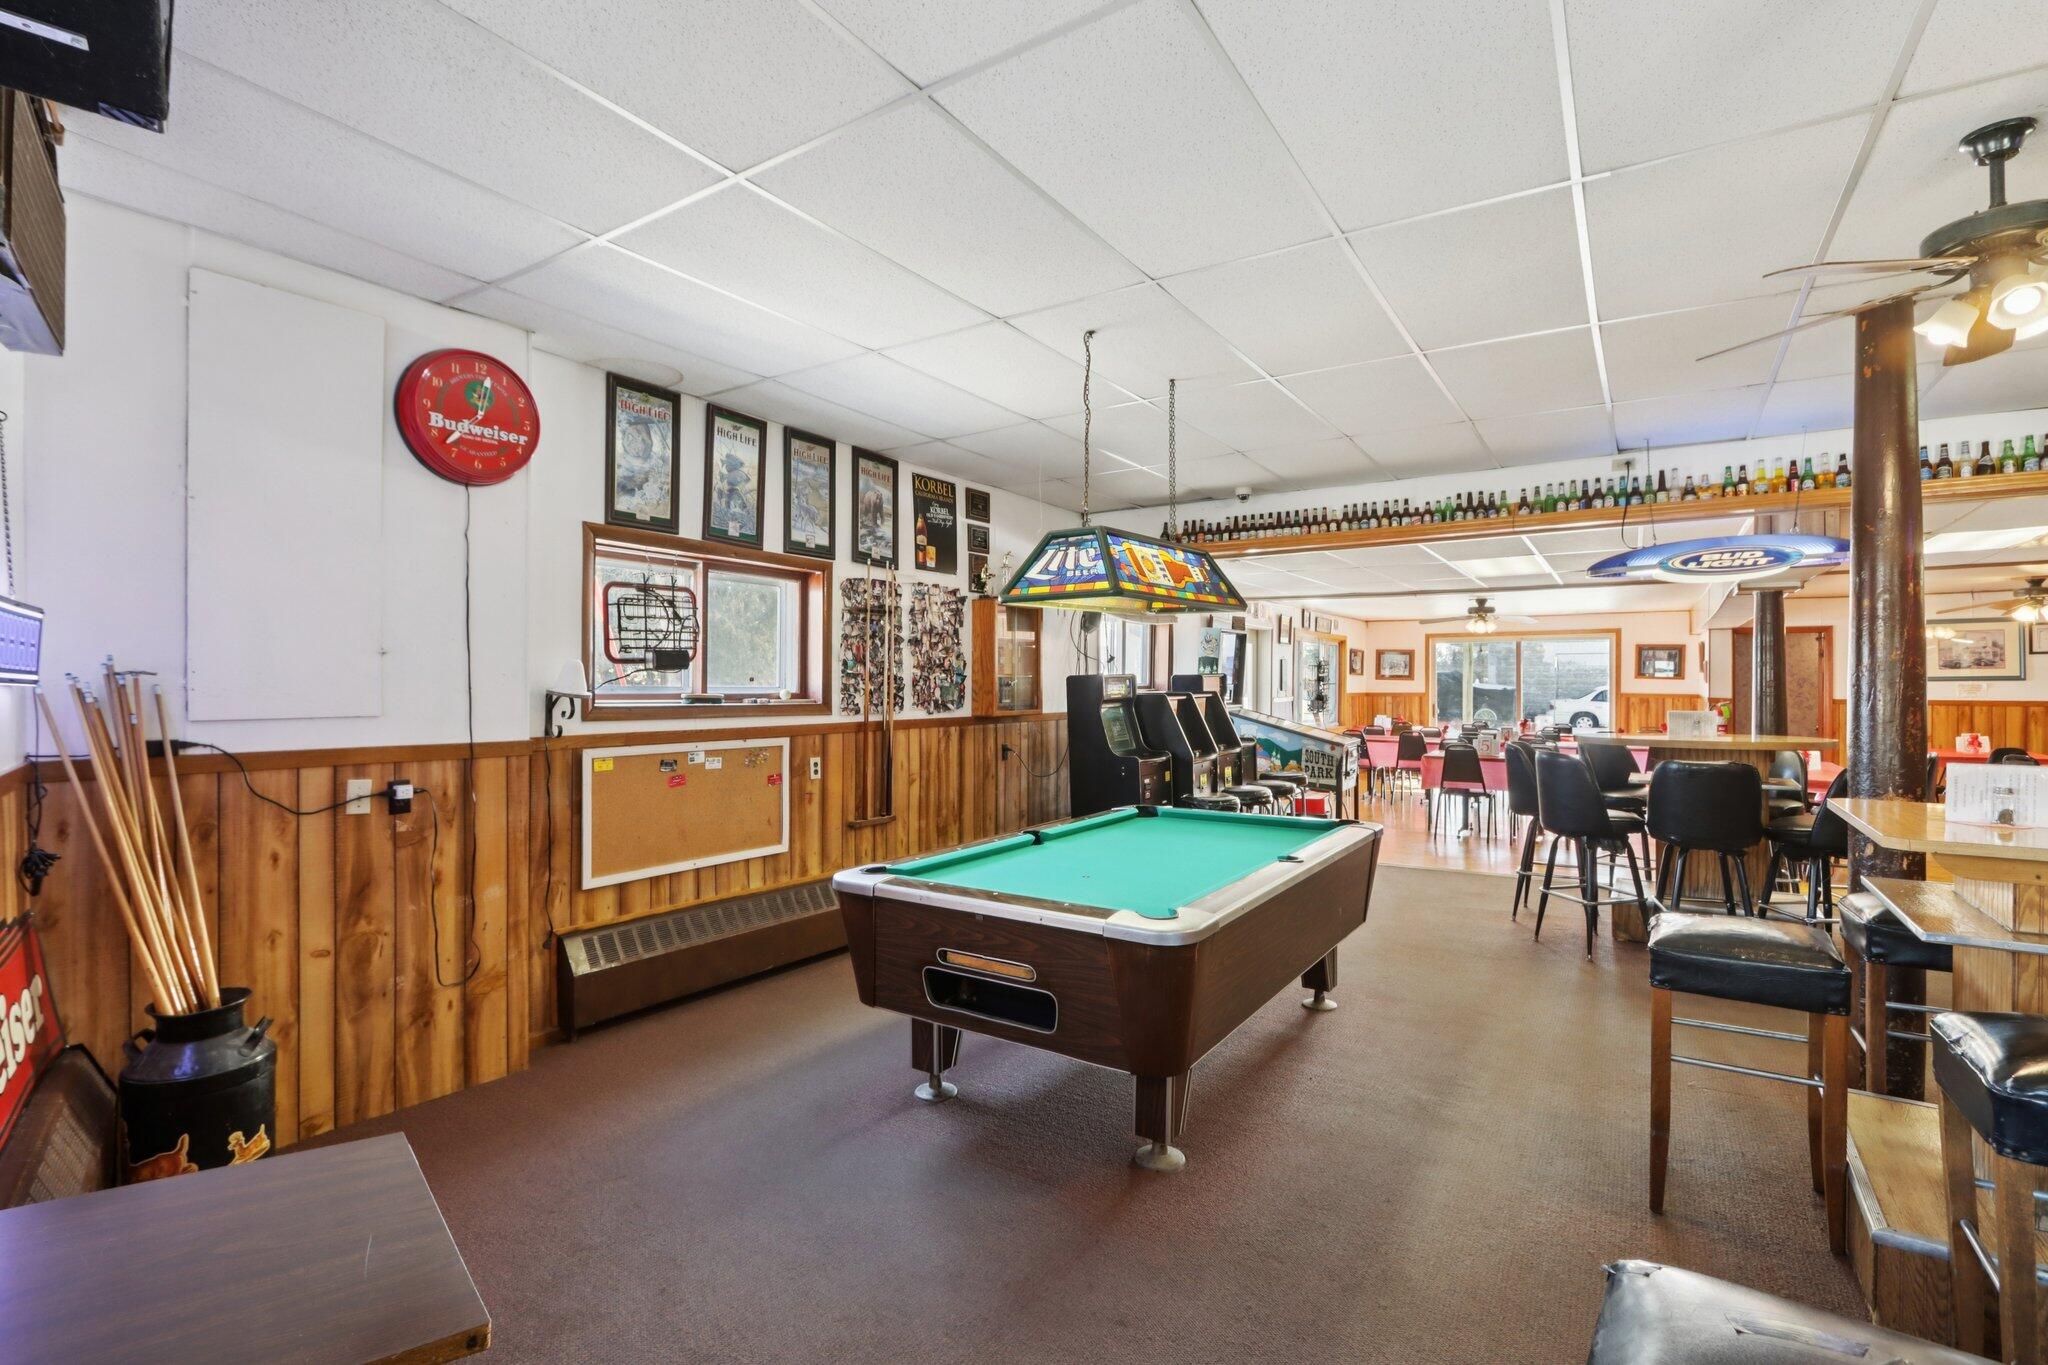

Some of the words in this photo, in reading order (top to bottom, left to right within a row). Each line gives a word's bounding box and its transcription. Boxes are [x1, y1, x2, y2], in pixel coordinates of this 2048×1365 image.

[451, 362, 460, 374] 11
[475, 362, 488, 374] 12
[432, 376, 443, 388] 10
[423, 398, 431, 408] 9
[428, 411, 529, 445] Budweiser
[716, 426, 738, 440] HIGH
[739, 433, 757, 447] LIFE
[451, 448, 458, 459] 7
[793, 448, 812, 459] HIGH
[474, 460, 482, 469] 6
[861, 467, 876, 479] HIGH
[915, 475, 955, 498] KORBEL
[1700, 550, 1764, 561] BUD
[1686, 557, 1774, 568] LIGHT
[1066, 568, 1098, 577] BEER
[1304, 749, 1334, 767] SOUTH
[1304, 765, 1334, 779] PARK
